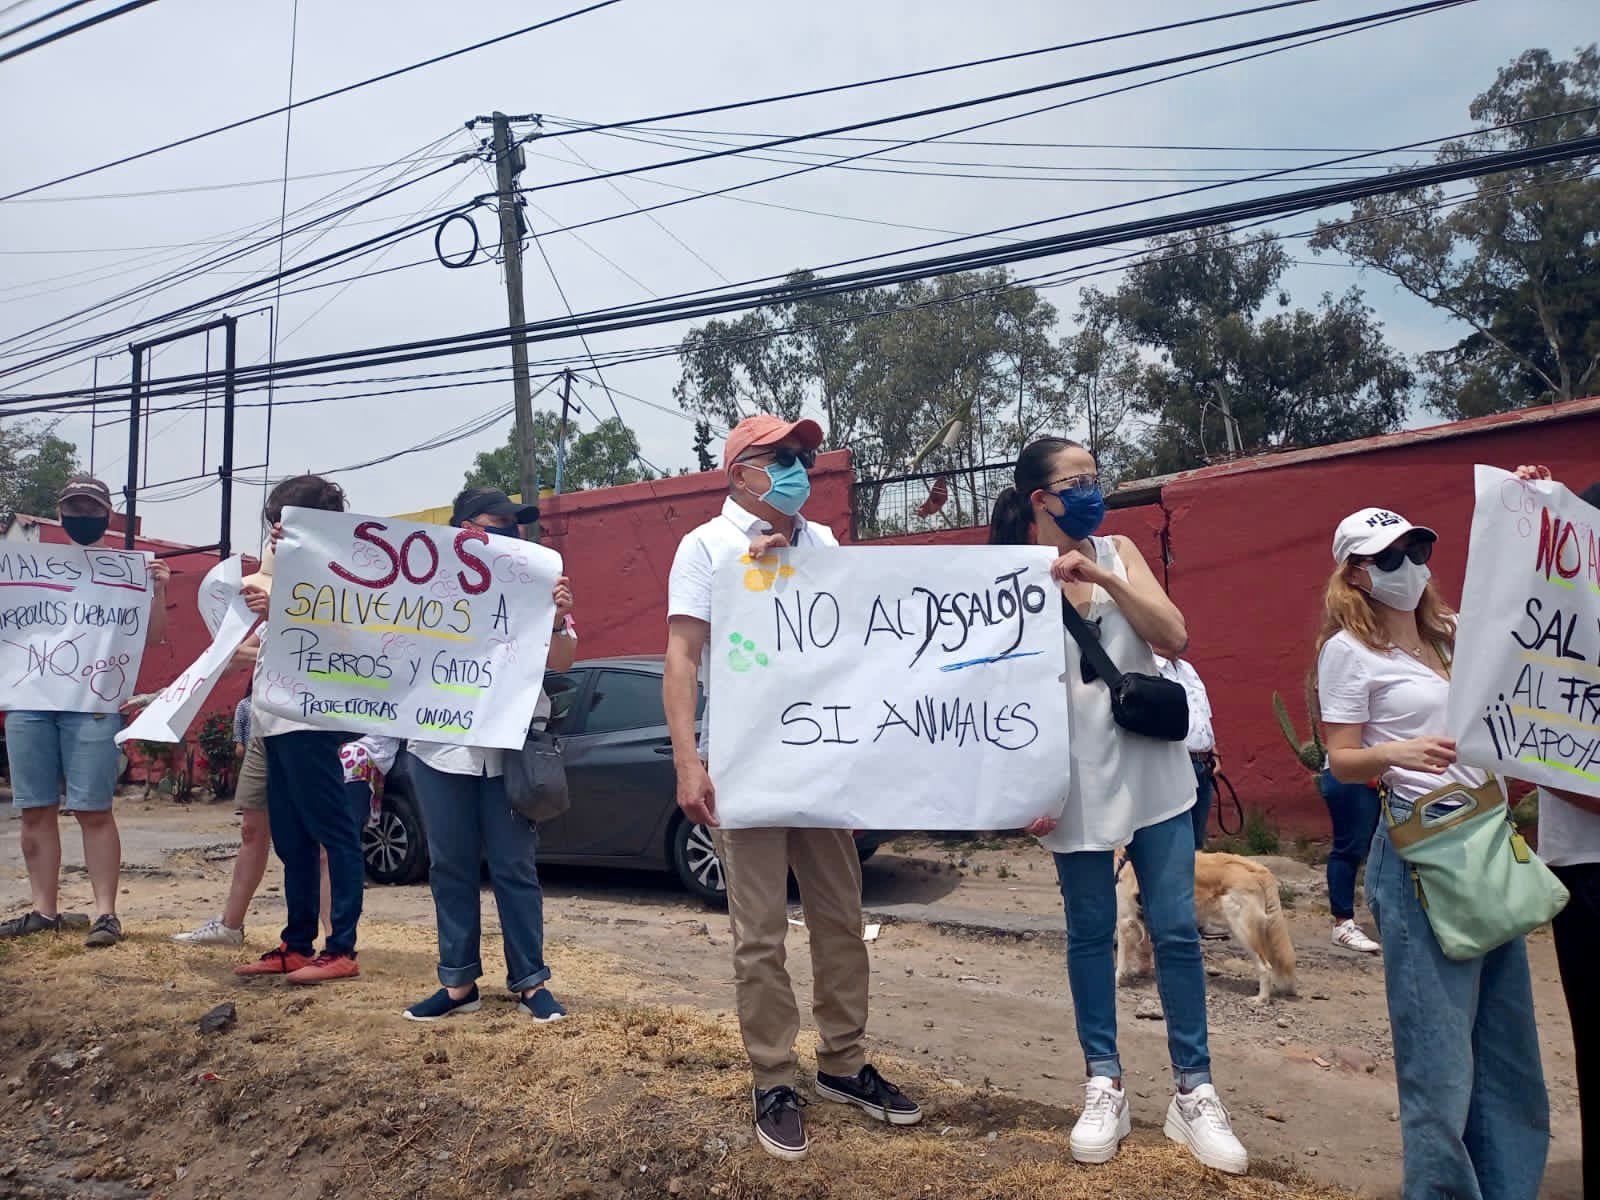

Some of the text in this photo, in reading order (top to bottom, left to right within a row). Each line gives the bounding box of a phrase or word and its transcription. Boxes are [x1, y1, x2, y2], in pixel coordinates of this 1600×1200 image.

[95, 554, 143, 586] SI
[328, 521, 491, 595] SOS
[1535, 505, 1582, 582] NO
[0, 600, 141, 637] RROLLOS URBANOS
[284, 582, 472, 634] SALVEMOS
[490, 592, 509, 635] A
[774, 566, 1046, 668] NO AL DESALOJO
[1510, 597, 1600, 668] SAL
[27, 639, 80, 677] NO
[280, 627, 393, 680] PERROS
[431, 649, 493, 689] GATOS
[297, 691, 474, 730] PROTECTORAS UNIDAS
[781, 695, 1039, 751] SI ANIMALES
[1512, 663, 1600, 725] AL FR
